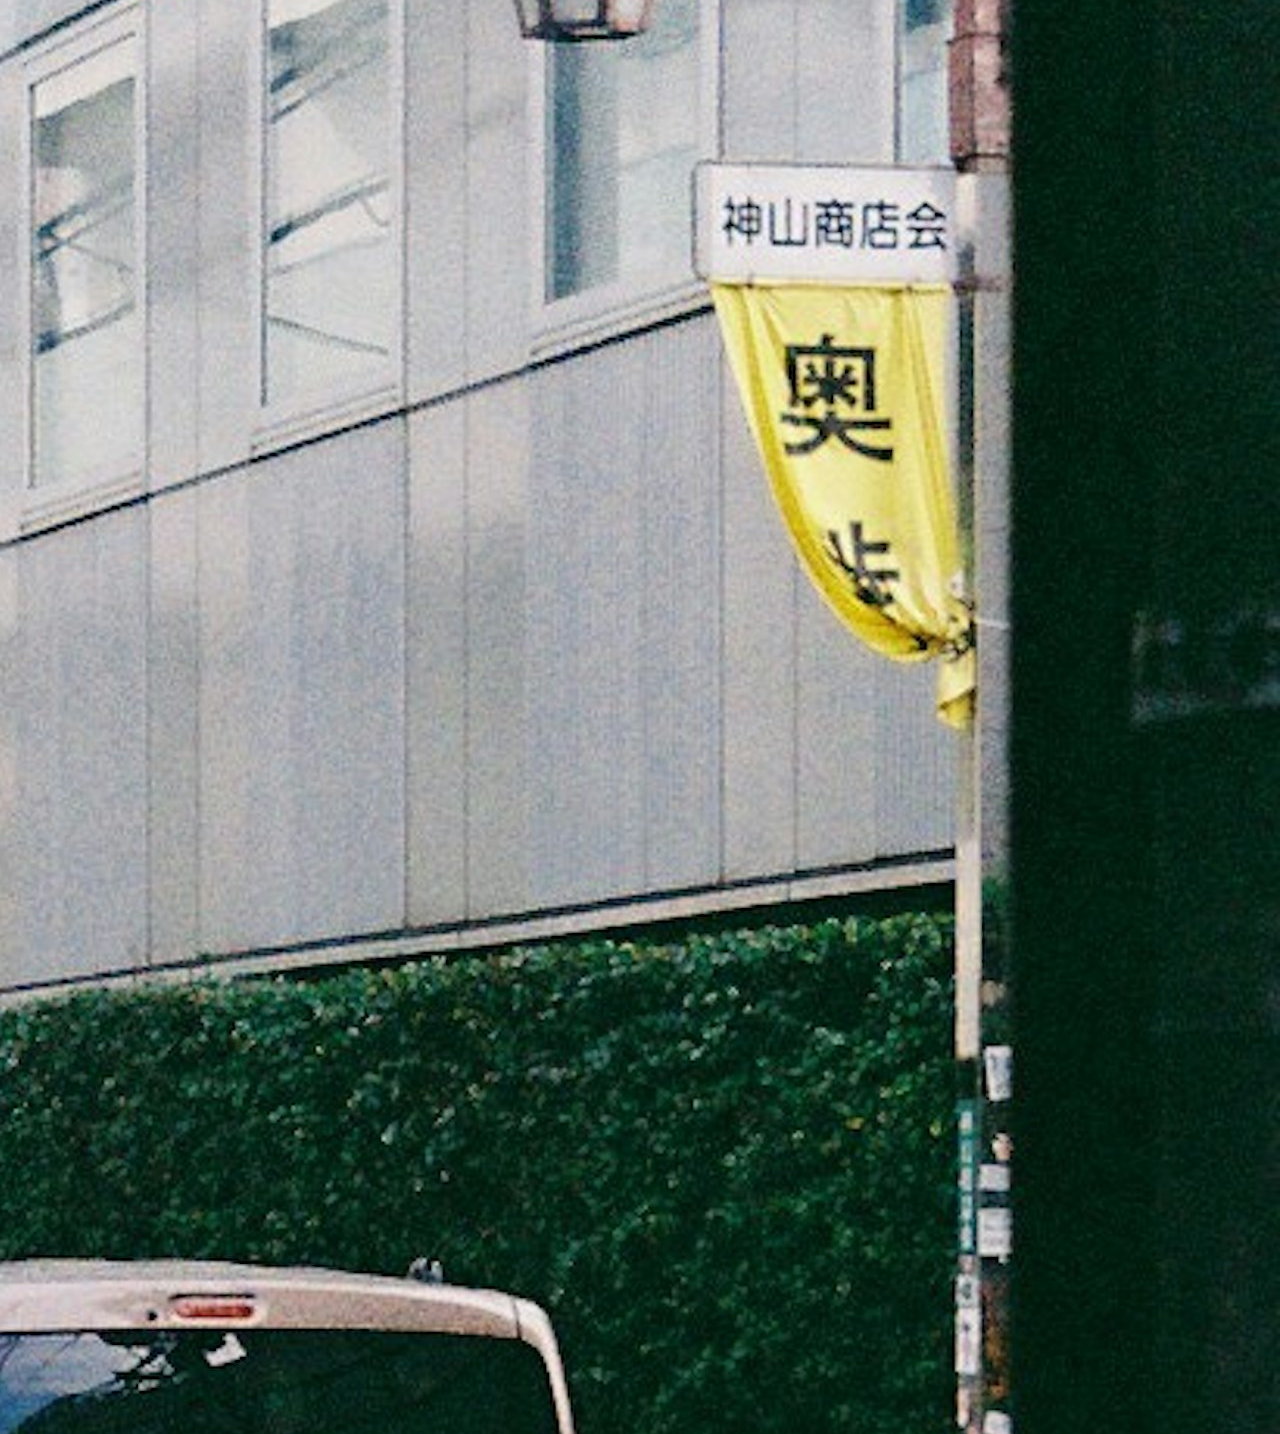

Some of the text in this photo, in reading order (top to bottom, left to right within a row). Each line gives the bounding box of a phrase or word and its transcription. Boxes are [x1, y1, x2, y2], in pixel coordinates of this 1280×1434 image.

[722, 196, 950, 252] 神山商店会
